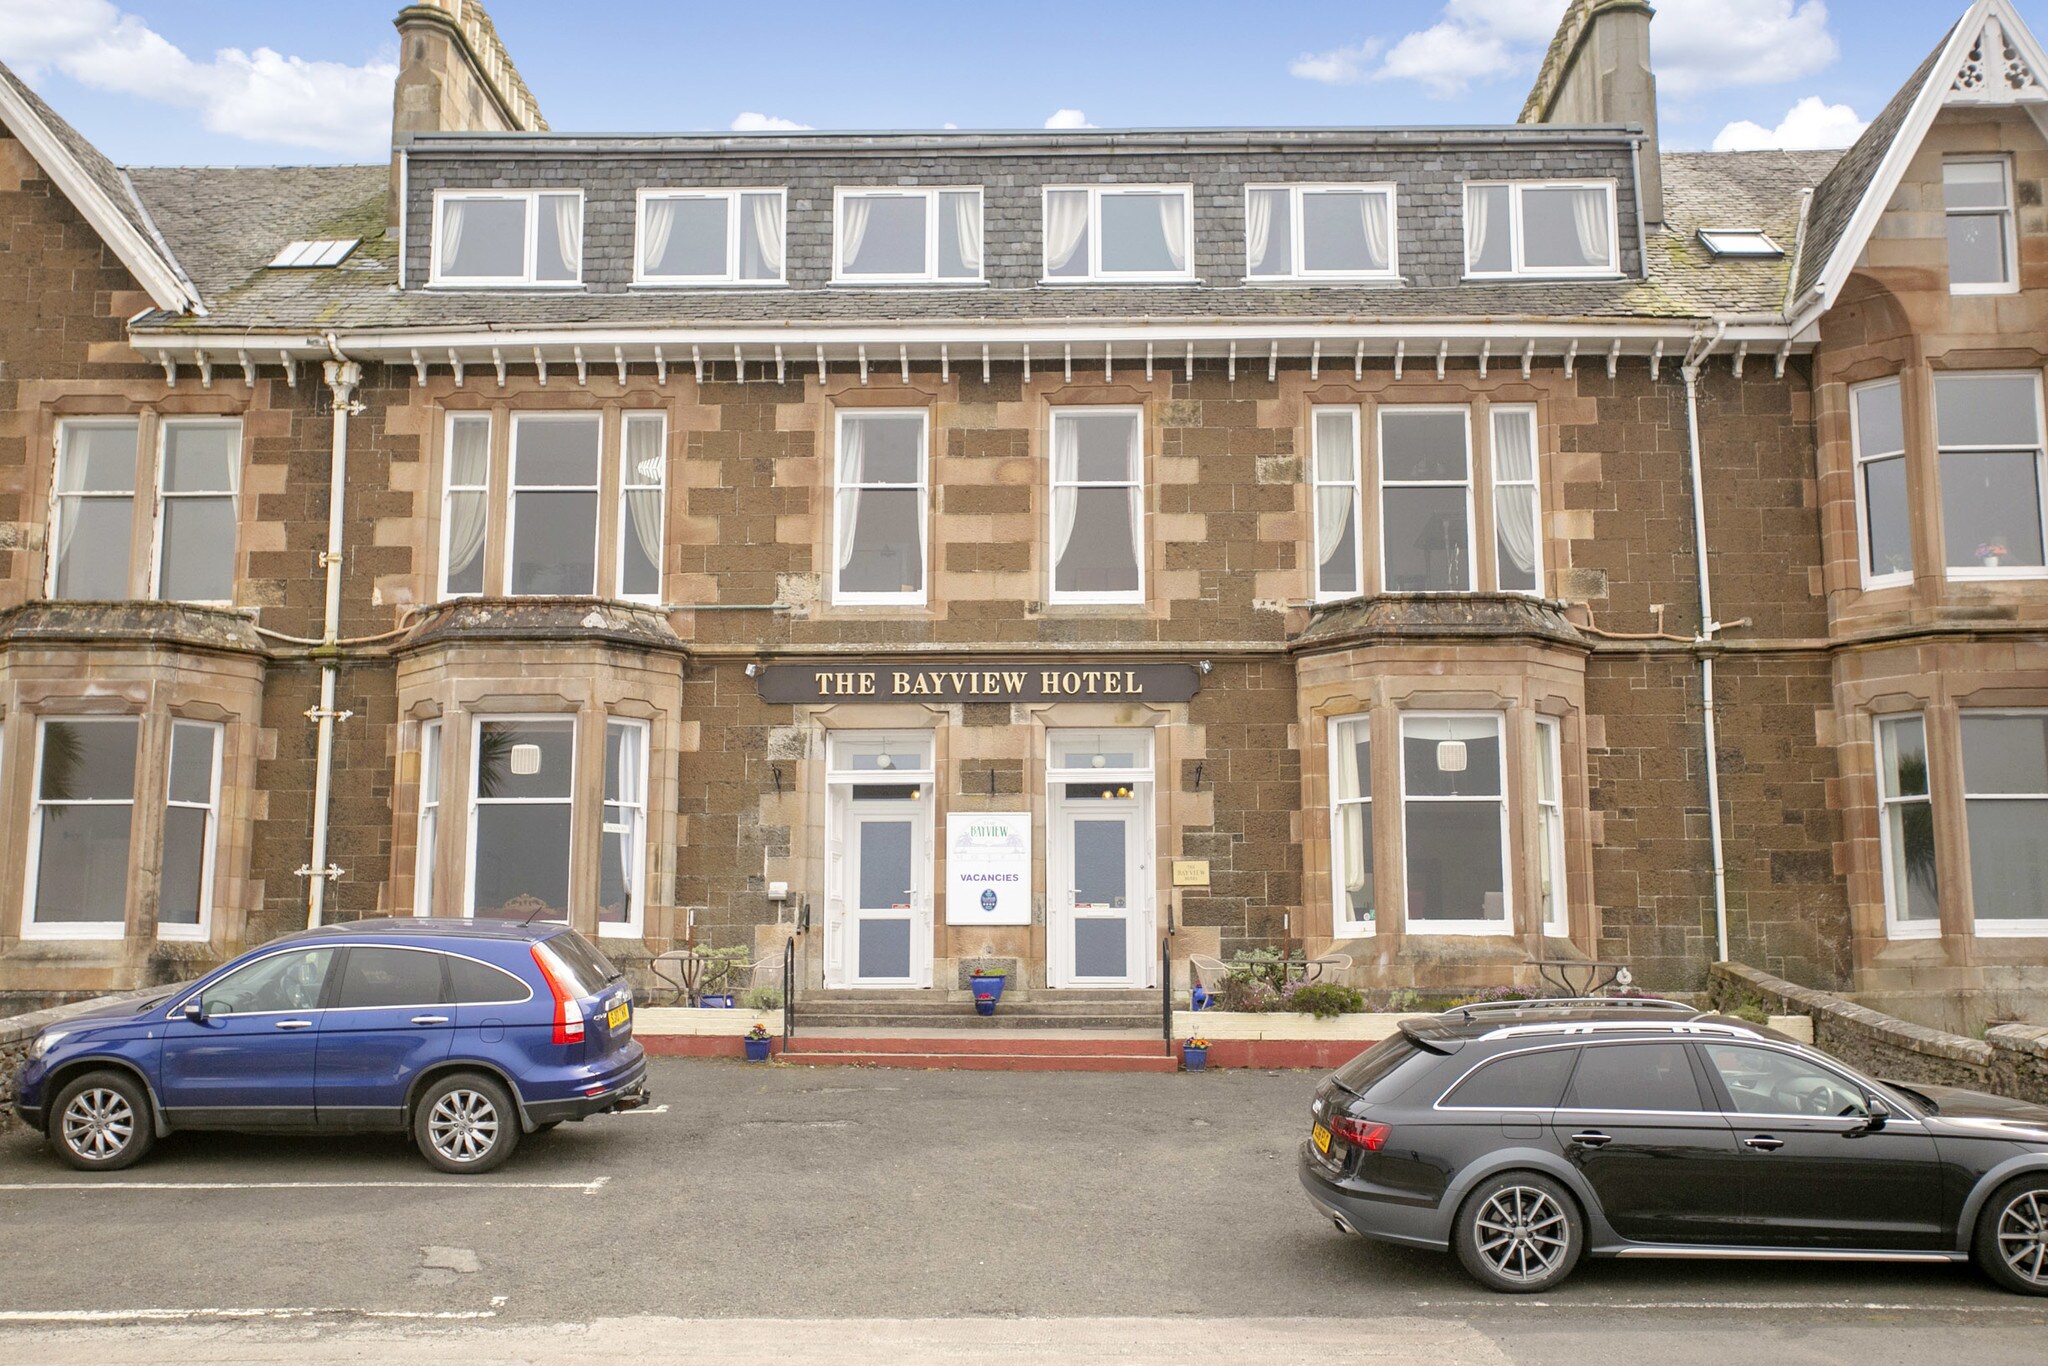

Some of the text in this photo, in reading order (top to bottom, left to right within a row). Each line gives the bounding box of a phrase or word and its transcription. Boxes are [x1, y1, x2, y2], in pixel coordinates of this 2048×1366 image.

[815, 671, 1143, 695] THE BAYVIEW HOTEL
[970, 826, 1008, 837] BAYVIEW
[960, 874, 1019, 882] VACANCIES
